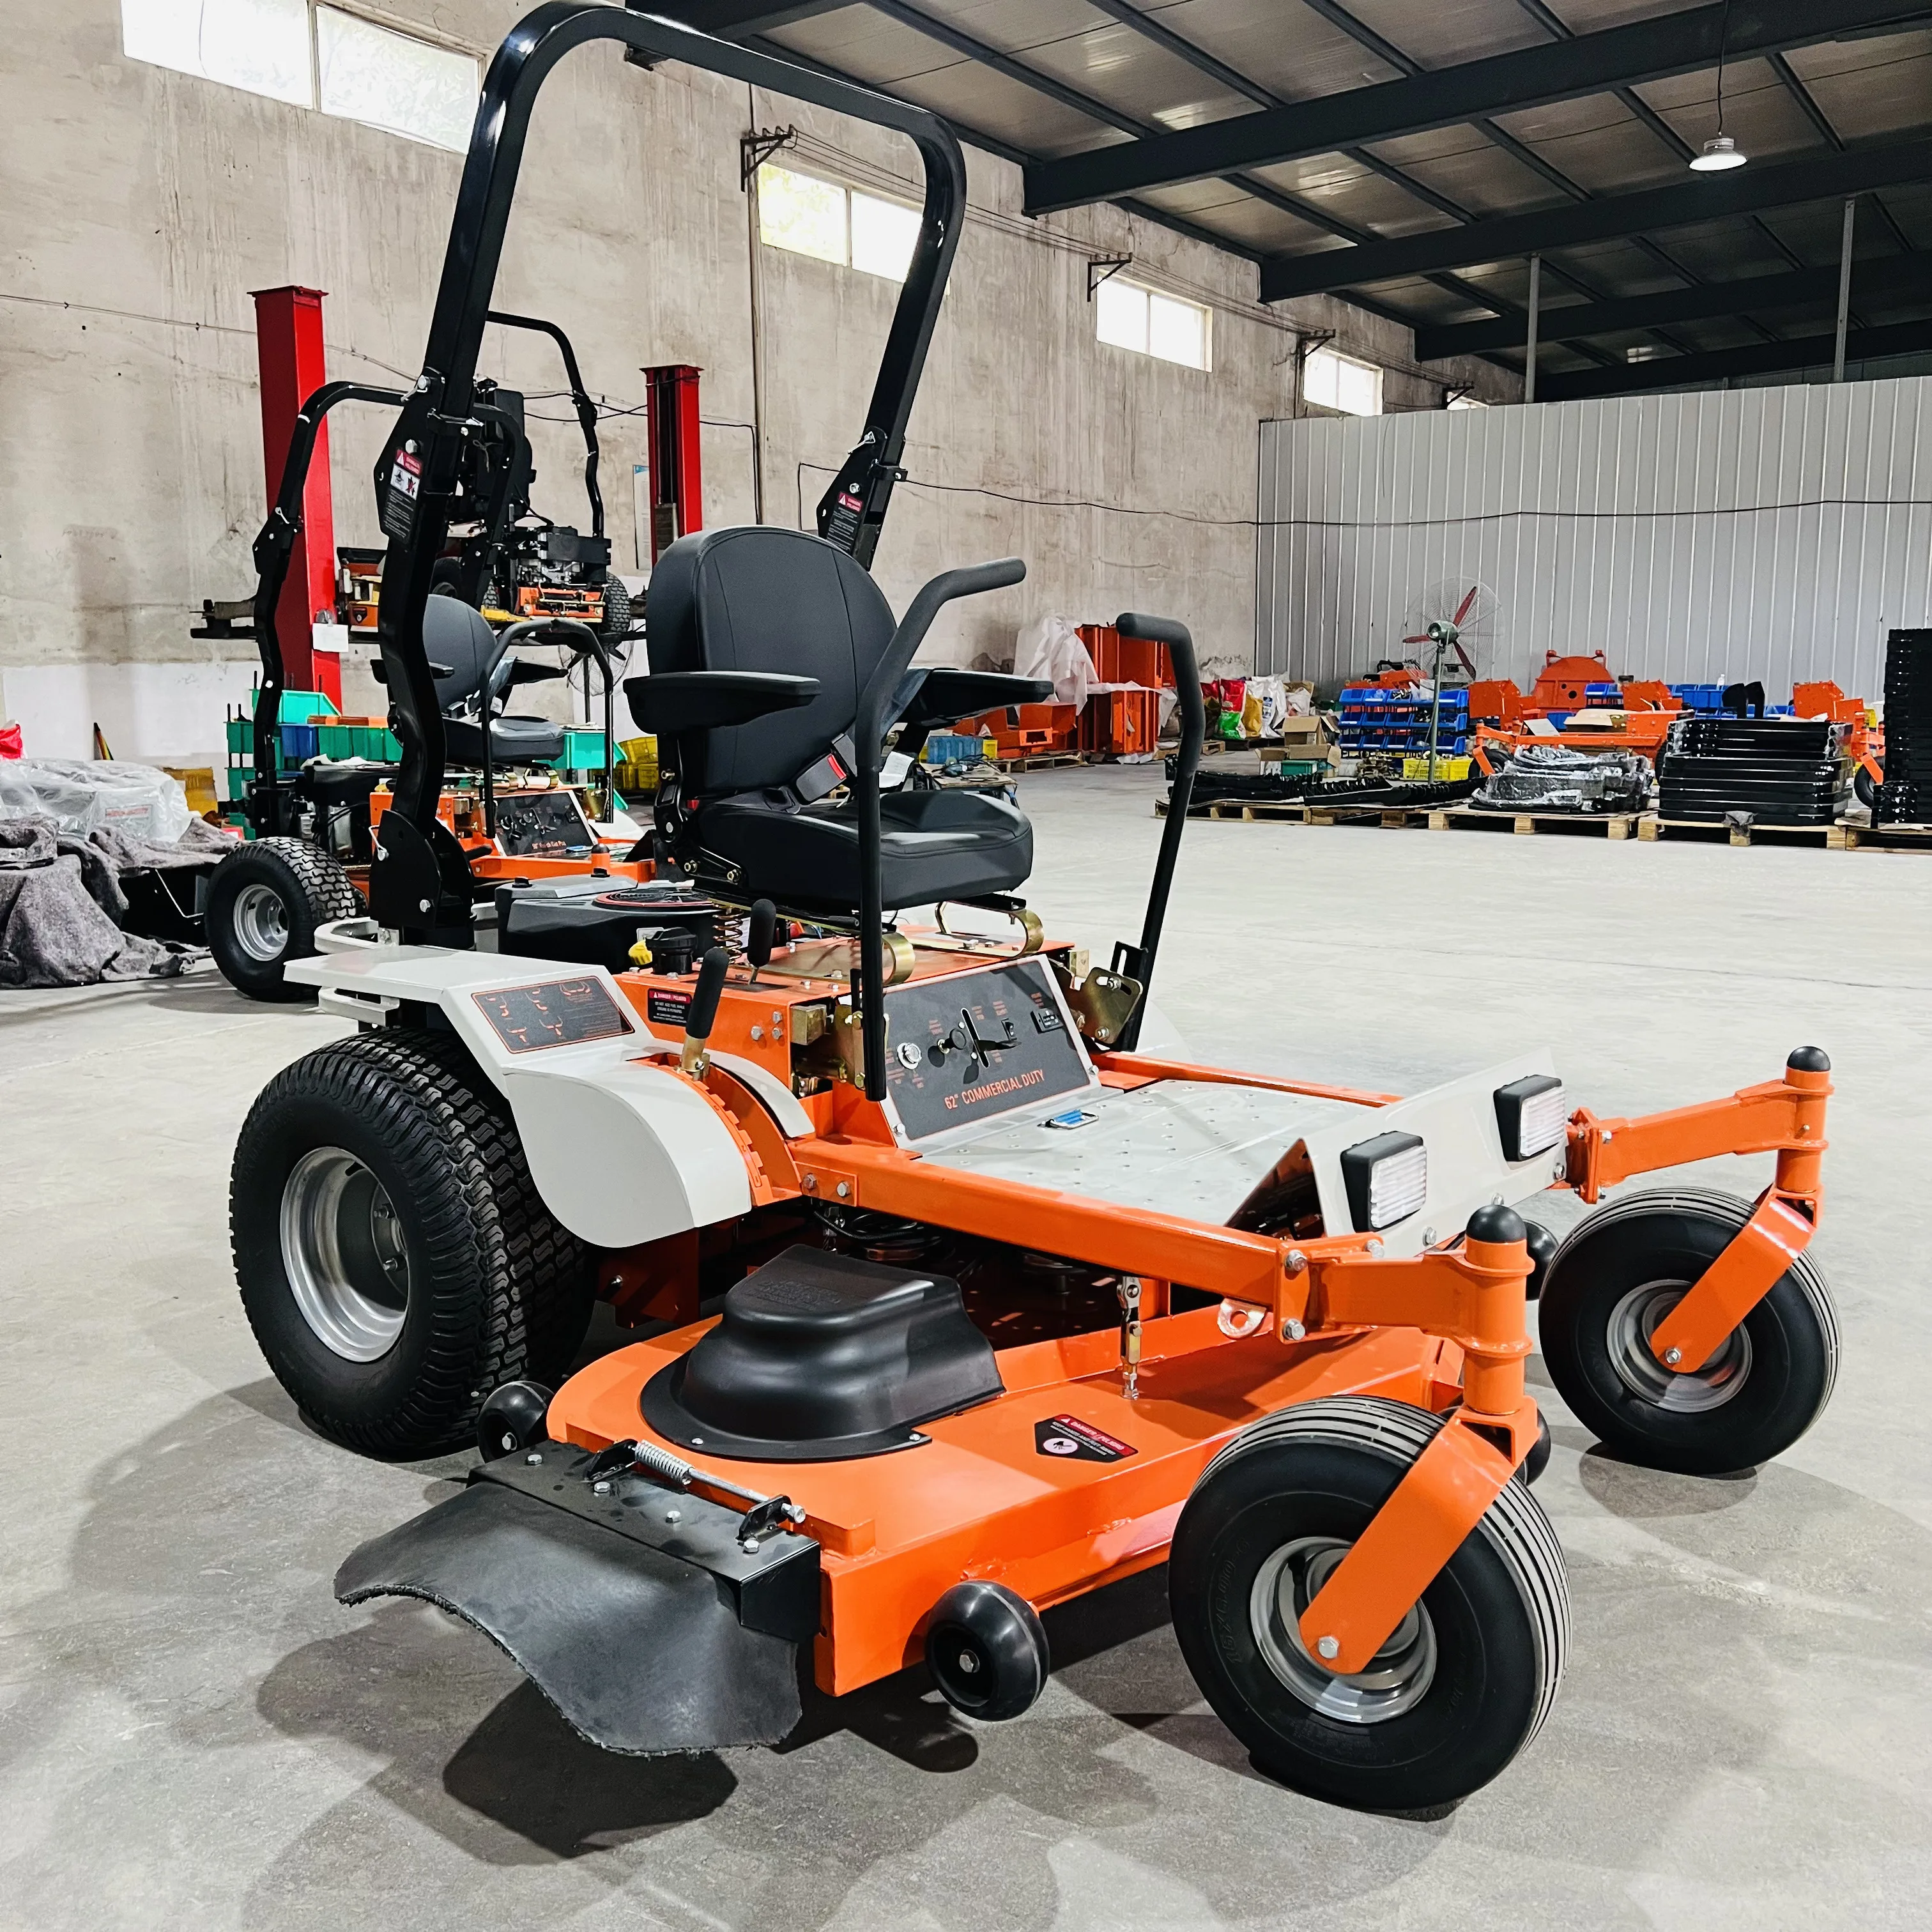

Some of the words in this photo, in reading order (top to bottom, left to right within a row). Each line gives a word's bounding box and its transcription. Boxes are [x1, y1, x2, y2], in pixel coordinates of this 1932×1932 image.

[944, 1093, 959, 1110] 62"
[961, 1076, 1023, 1105] COMMERCIAL
[1021, 1068, 1045, 1087] DUTY
[1070, 1422, 1097, 1436] DANGER
